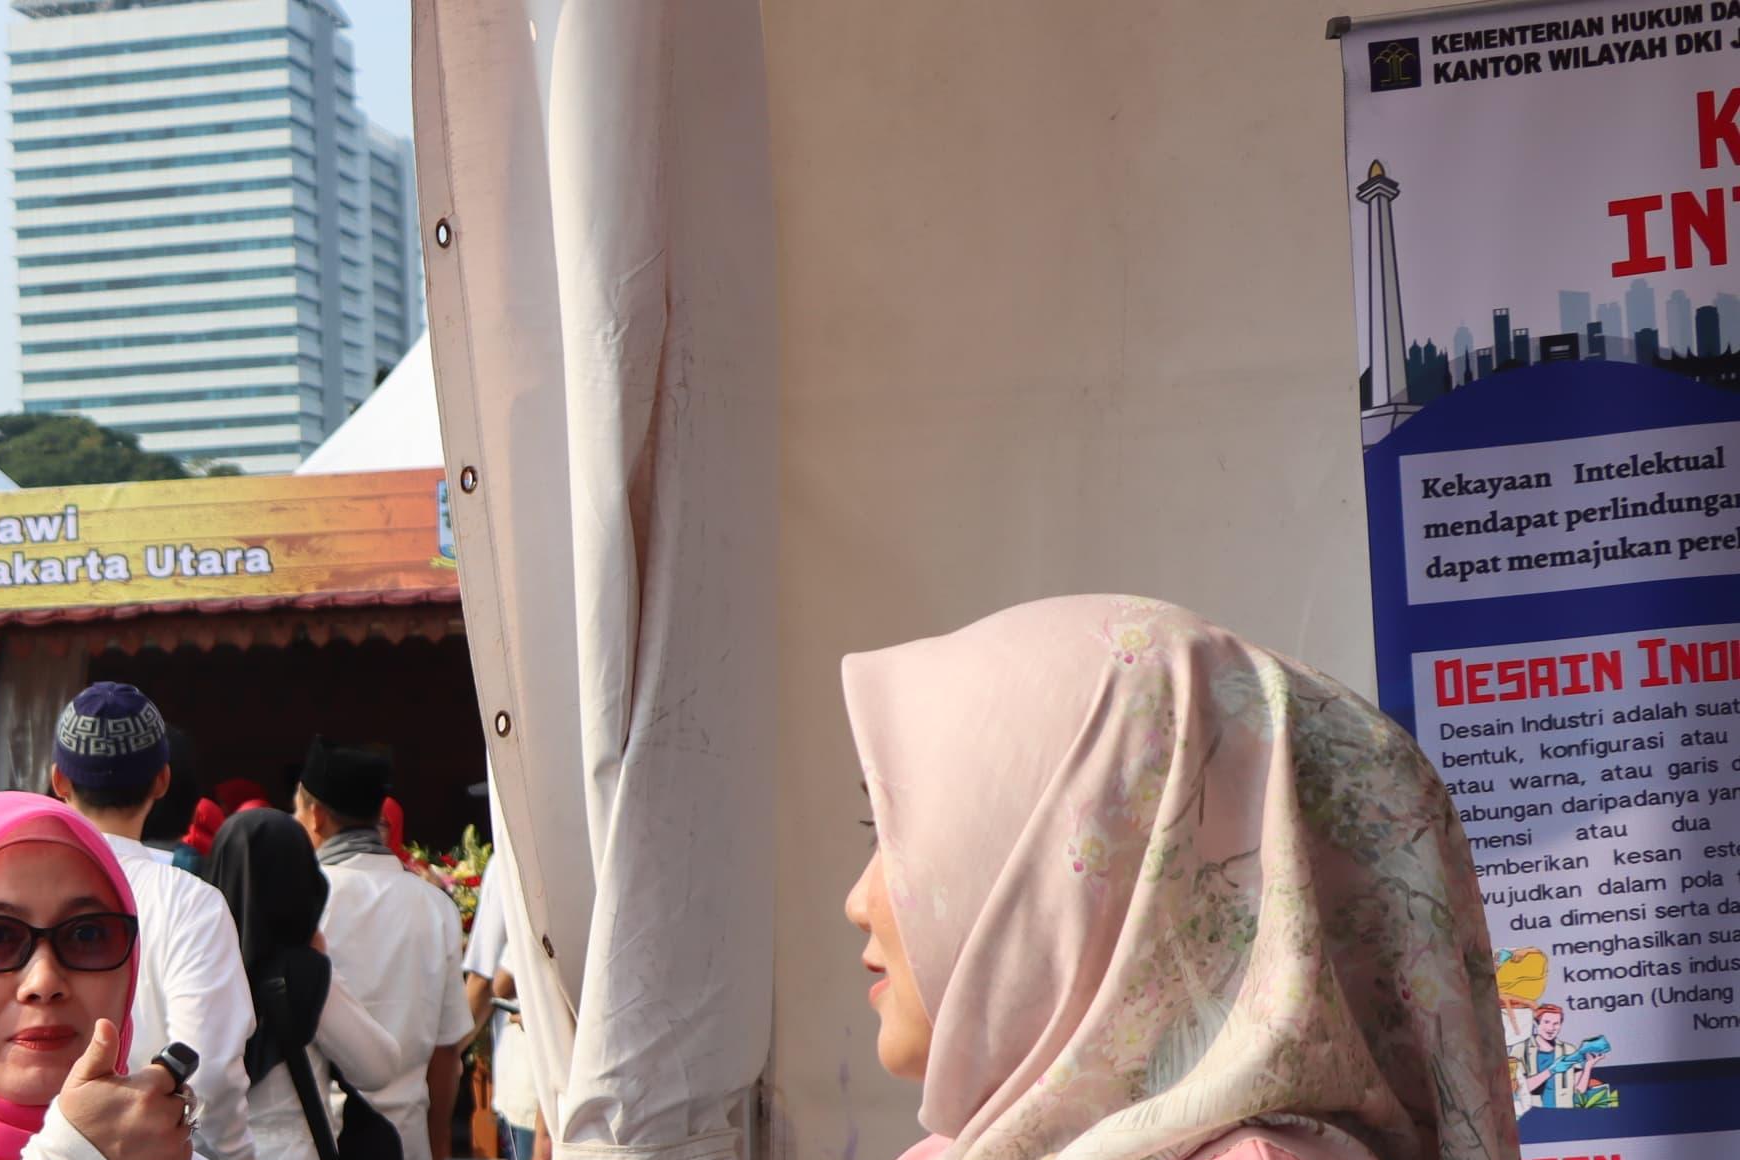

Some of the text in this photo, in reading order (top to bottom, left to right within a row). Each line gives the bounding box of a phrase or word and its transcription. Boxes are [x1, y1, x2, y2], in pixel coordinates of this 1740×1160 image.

[1432, 16, 1604, 55] KEMENTERIAN
[1612, 3, 1704, 38] HUKUM
[1433, 51, 1541, 84] KANTOR
[1548, 37, 1668, 71] WILAYAH
[1675, 29, 1722, 56] DKI
[1607, 185, 1740, 278] IN
[1421, 446, 1725, 500] Kekayaan Intelektual
[1423, 509, 1559, 539] mendapat
[145, 543, 274, 579] Utara
[1425, 556, 1502, 582] dapat
[1507, 535, 1671, 572] memajukan
[1434, 649, 1625, 708] DESAIN
[1440, 718, 1514, 741] Desain
[1521, 709, 1604, 732] Industri
[1613, 701, 1688, 725] adalah
[1442, 729, 1729, 769] bentuk, konfigurasi atau
[1447, 775, 1495, 796] atau
[1509, 769, 1587, 791] warna,
[1600, 761, 1653, 782] atau
[1667, 756, 1719, 780] garis
[1460, 798, 1553, 824] abungan
[1561, 786, 1699, 816] daripadanya
[1469, 815, 1711, 850] mensi atau dua
[1474, 854, 1589, 879] emberikan
[1613, 846, 1682, 866] kesan
[1598, 875, 1667, 897] dalam
[1681, 870, 1724, 894] pola
[1510, 913, 1552, 932] dua
[1560, 904, 1647, 928] dimensi
[1654, 901, 1710, 920] serta
[1552, 930, 1702, 957] menghasilkan
[1563, 959, 1682, 984] komoditas
[1566, 983, 1734, 1013] tangan (Undang
